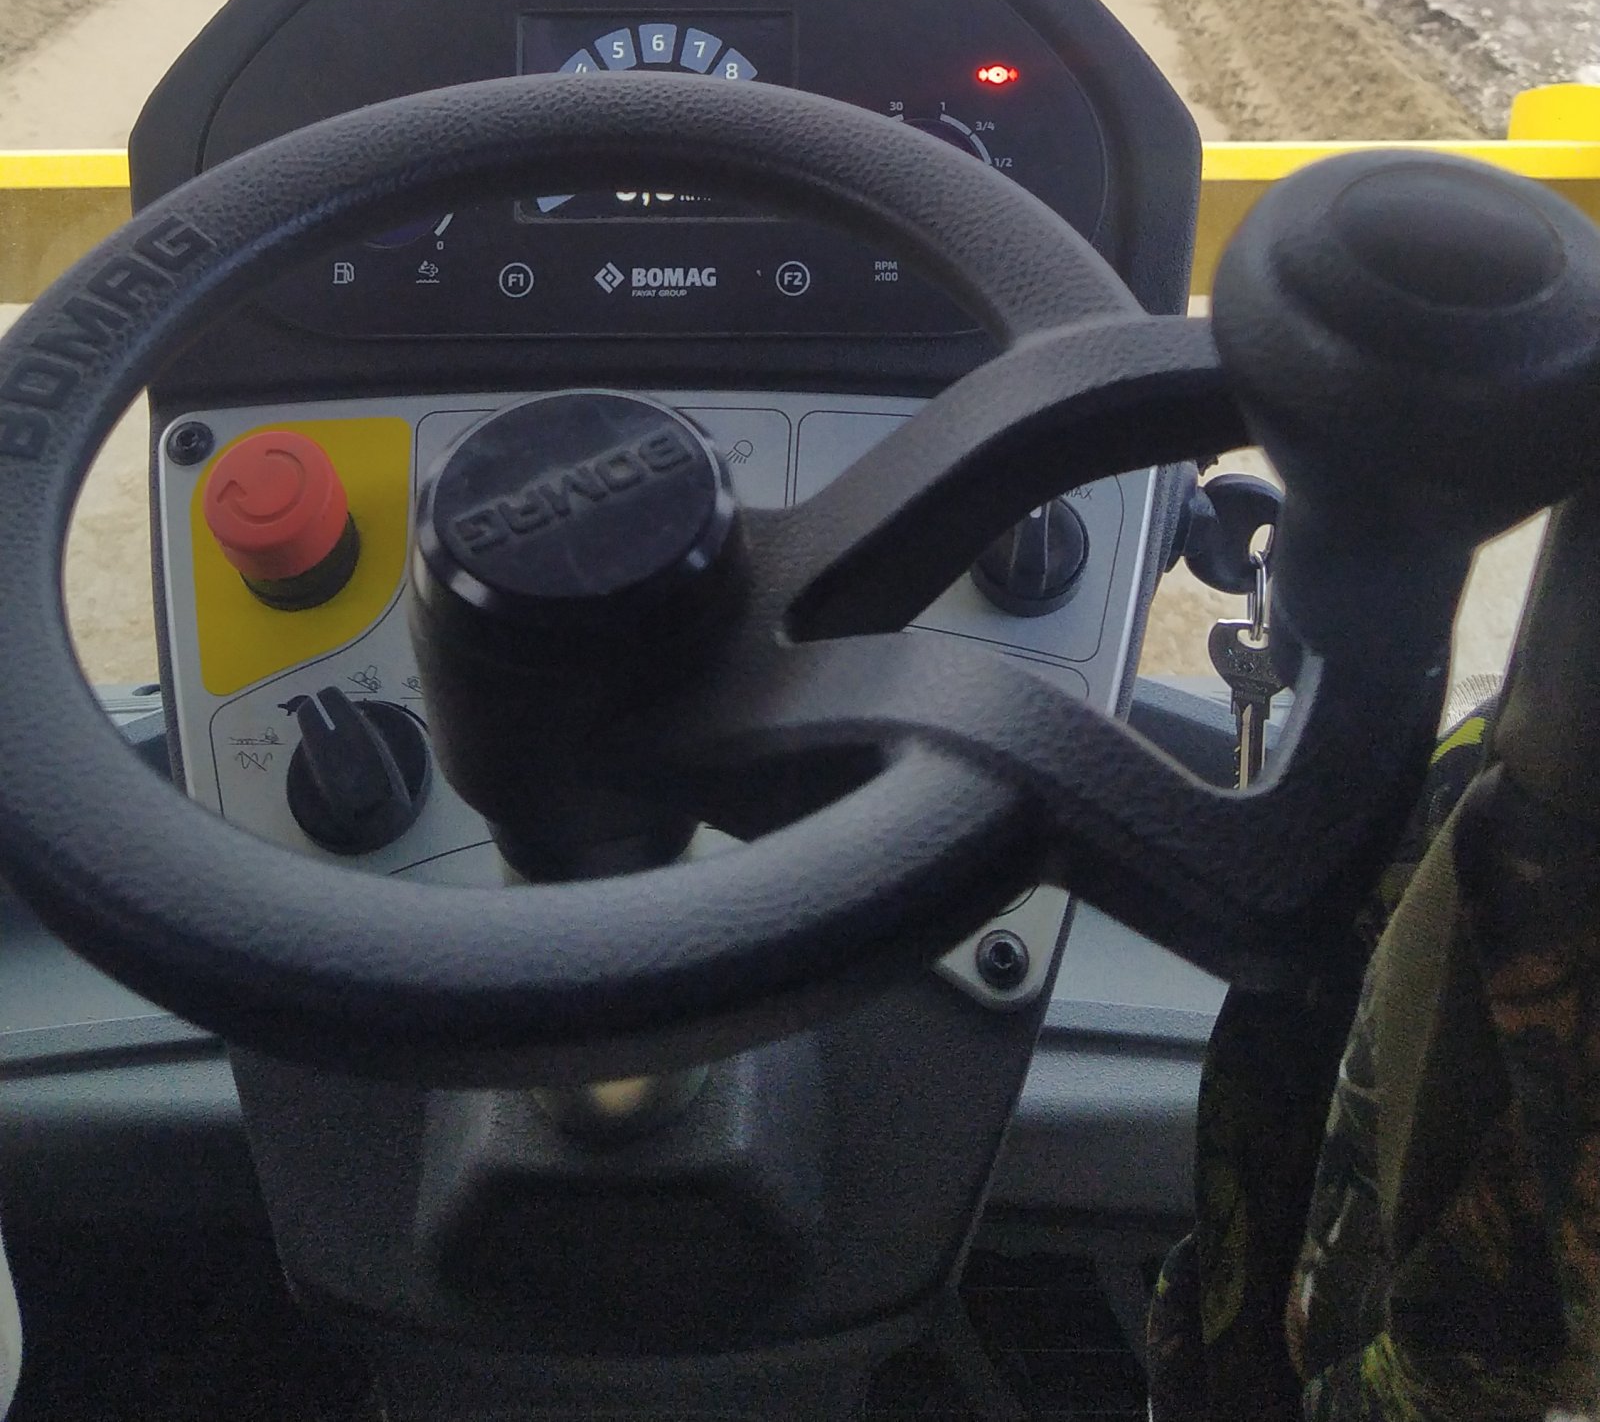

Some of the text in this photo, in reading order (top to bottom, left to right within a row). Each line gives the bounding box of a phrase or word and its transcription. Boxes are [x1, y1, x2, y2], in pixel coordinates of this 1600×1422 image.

[612, 41, 625, 59] 5
[651, 34, 665, 52] 6
[693, 41, 706, 58] 7
[725, 62, 739, 80] 8
[889, 101, 904, 111] 30
[940, 101, 946, 111] 1
[975, 121, 995, 132] 3/4
[994, 157, 1013, 168] 1/2
[436, 240, 445, 251] 0
[874, 260, 898, 271] RPM
[508, 273, 525, 287] F1
[631, 267, 717, 288] BOMAG
[784, 271, 803, 286] F2
[874, 272, 898, 282] x100
[631, 289, 688, 298] FAYAT GROUP
[455, 428, 693, 555] BOMAG
